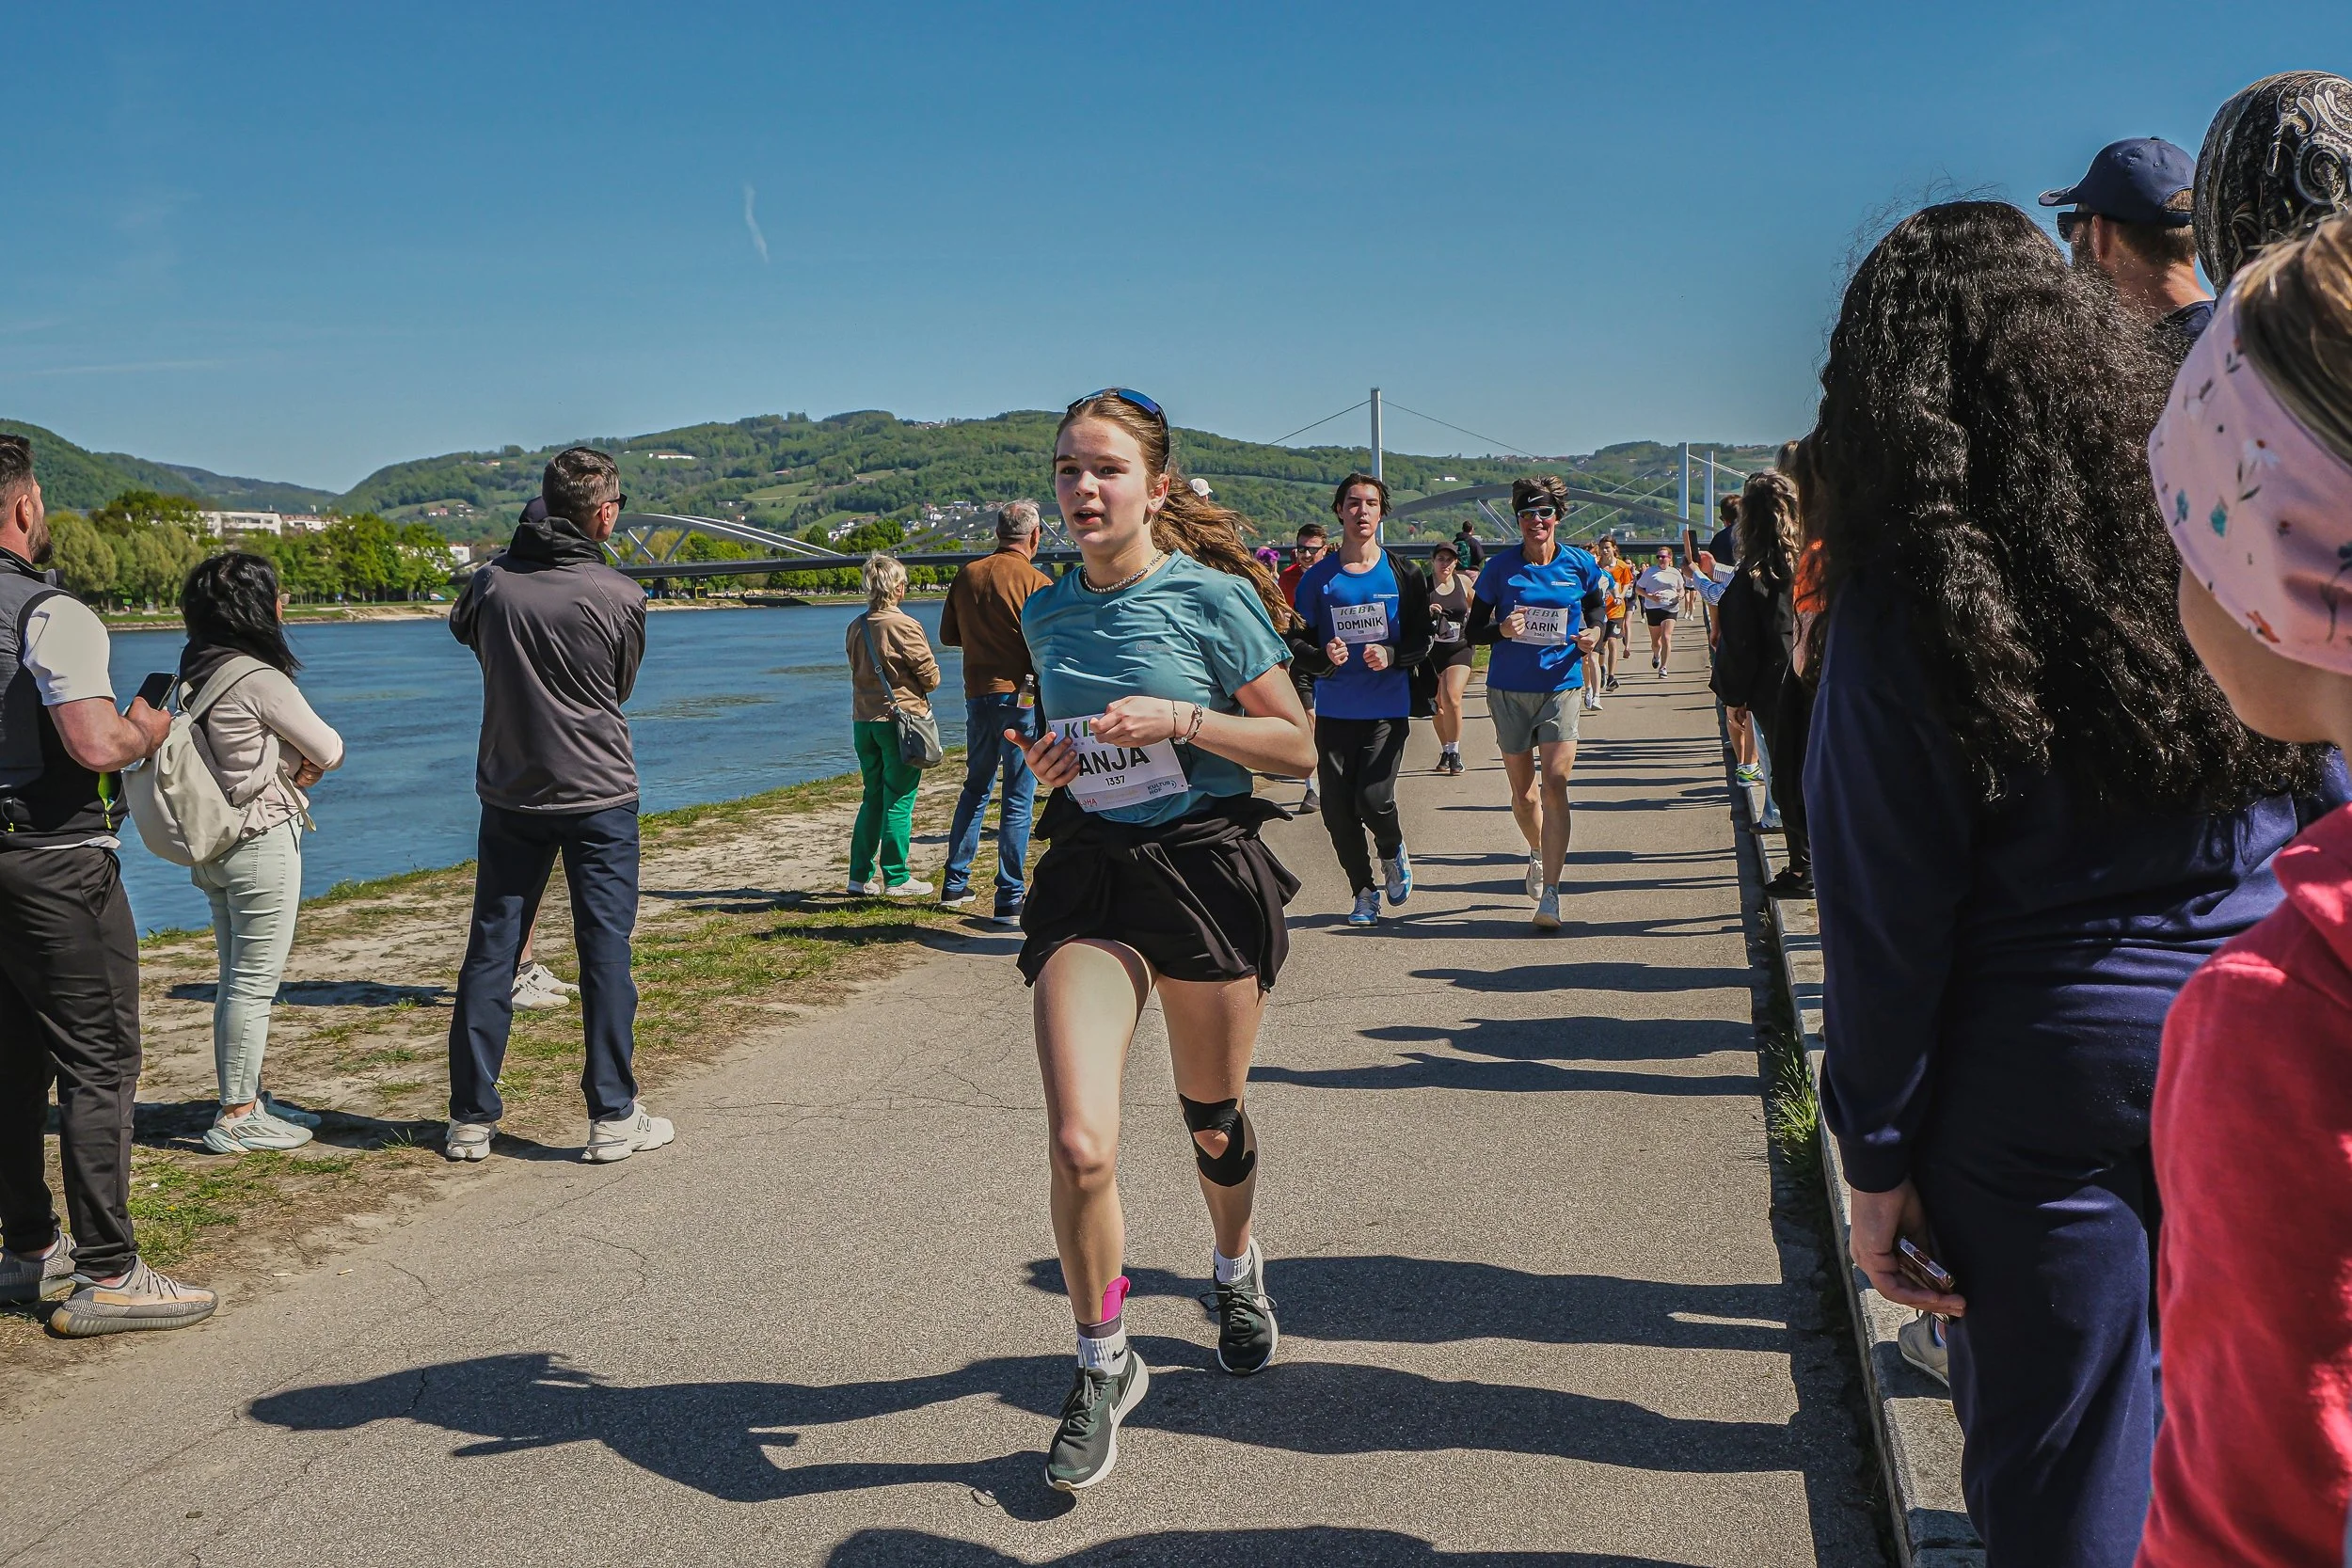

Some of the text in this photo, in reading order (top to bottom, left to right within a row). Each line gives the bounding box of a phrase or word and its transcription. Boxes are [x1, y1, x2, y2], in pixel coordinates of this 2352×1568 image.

[1340, 605, 1375, 616] KEBA
[1337, 616, 1384, 631] DOMINIK
[1104, 774, 1125, 786] 1337
